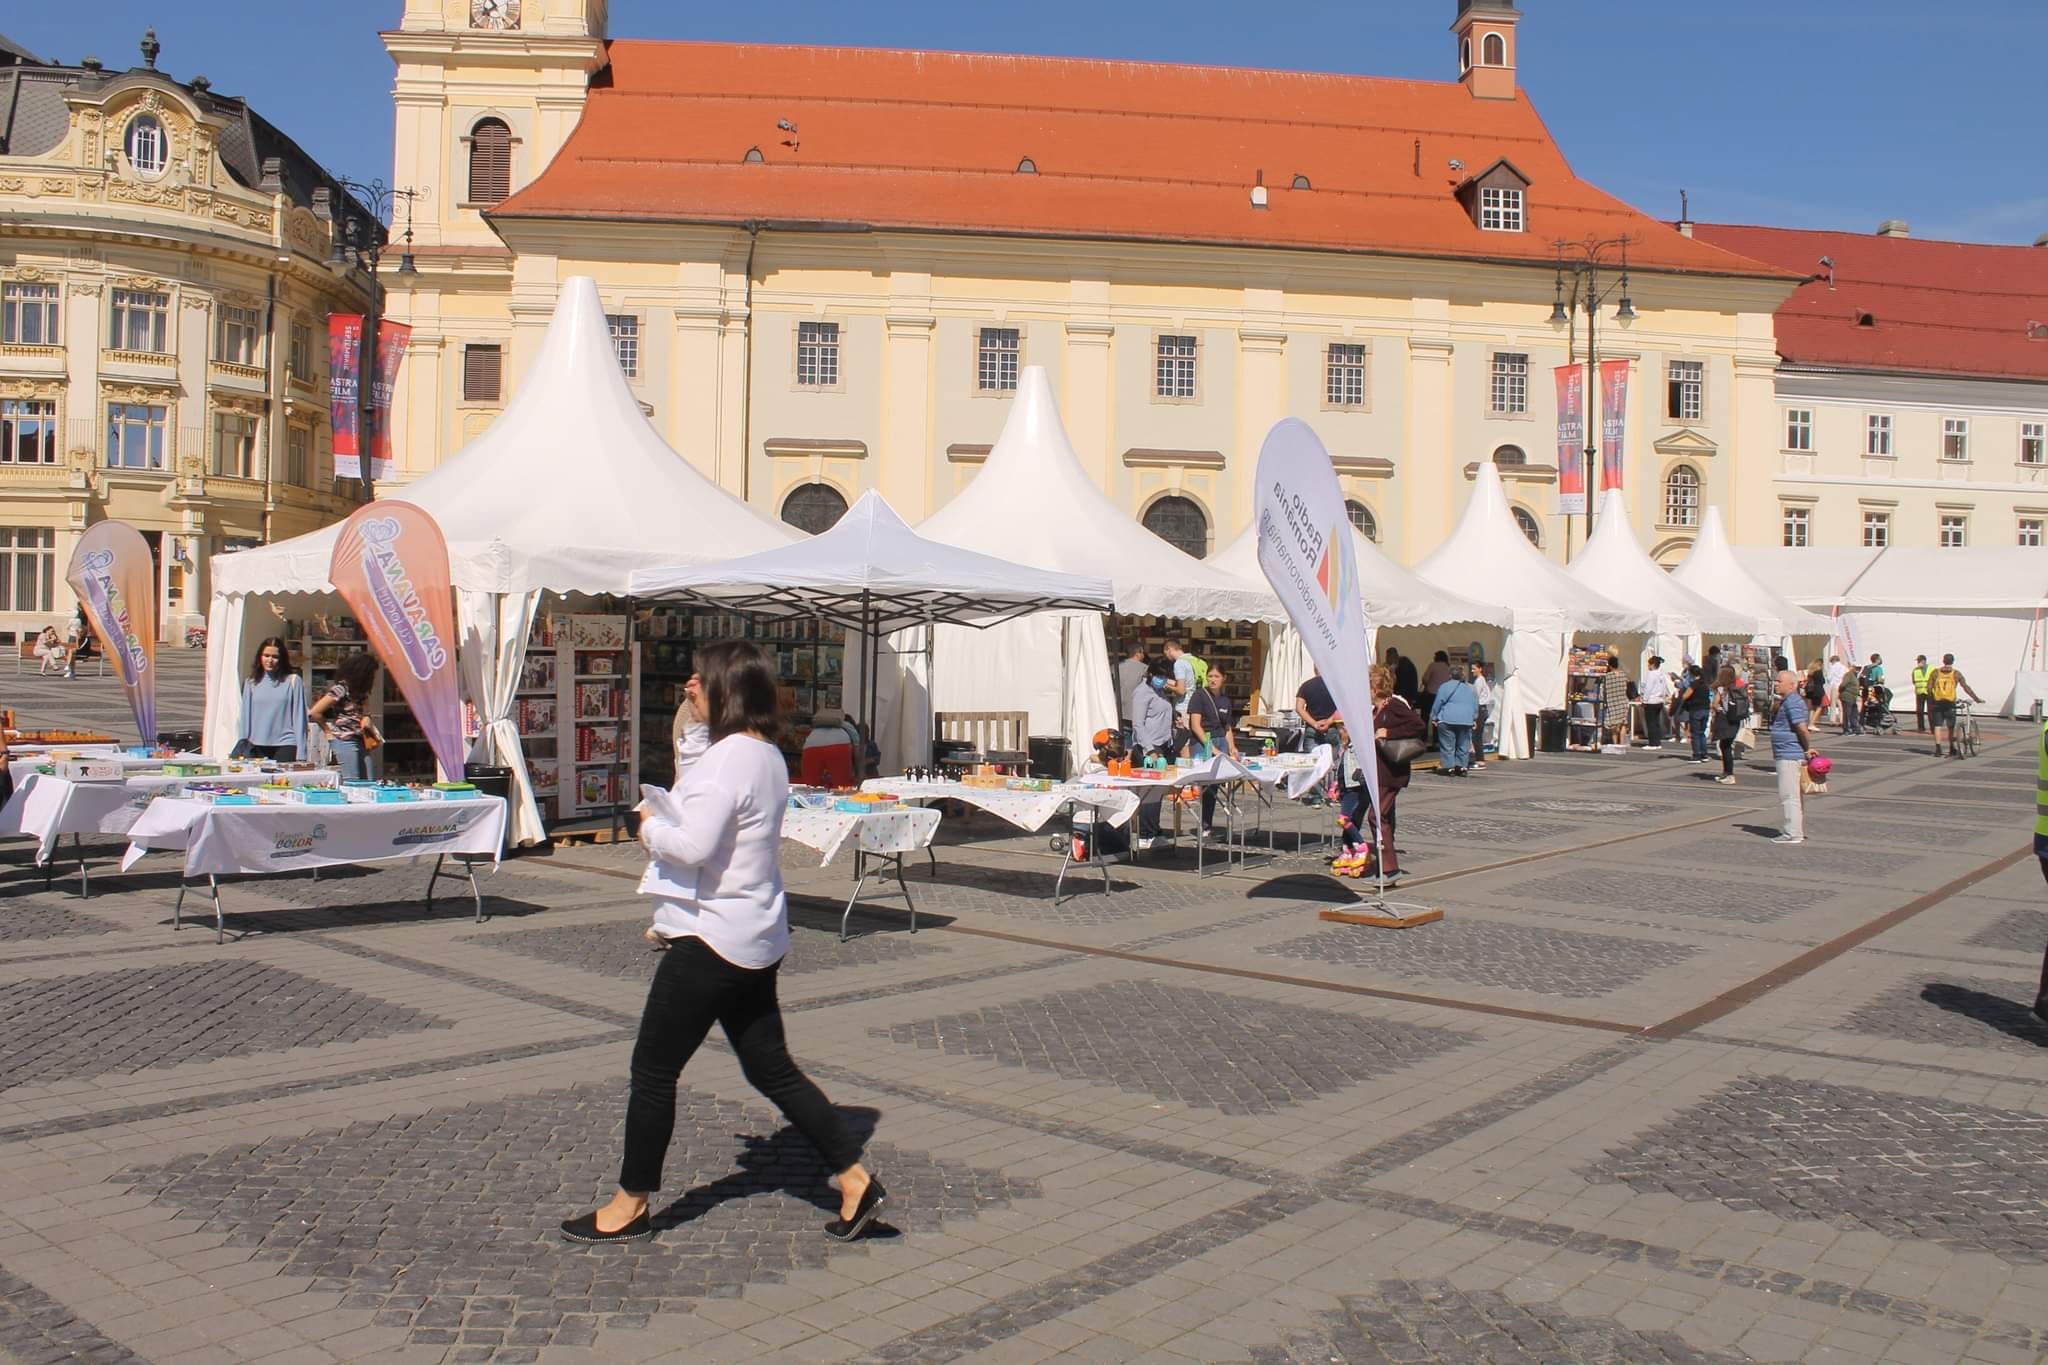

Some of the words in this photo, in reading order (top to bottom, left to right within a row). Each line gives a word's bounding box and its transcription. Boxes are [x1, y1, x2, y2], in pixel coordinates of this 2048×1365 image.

[330, 377, 358, 387] ASTRA
[330, 386, 351, 395] FILM
[276, 837, 313, 849] COLOR
